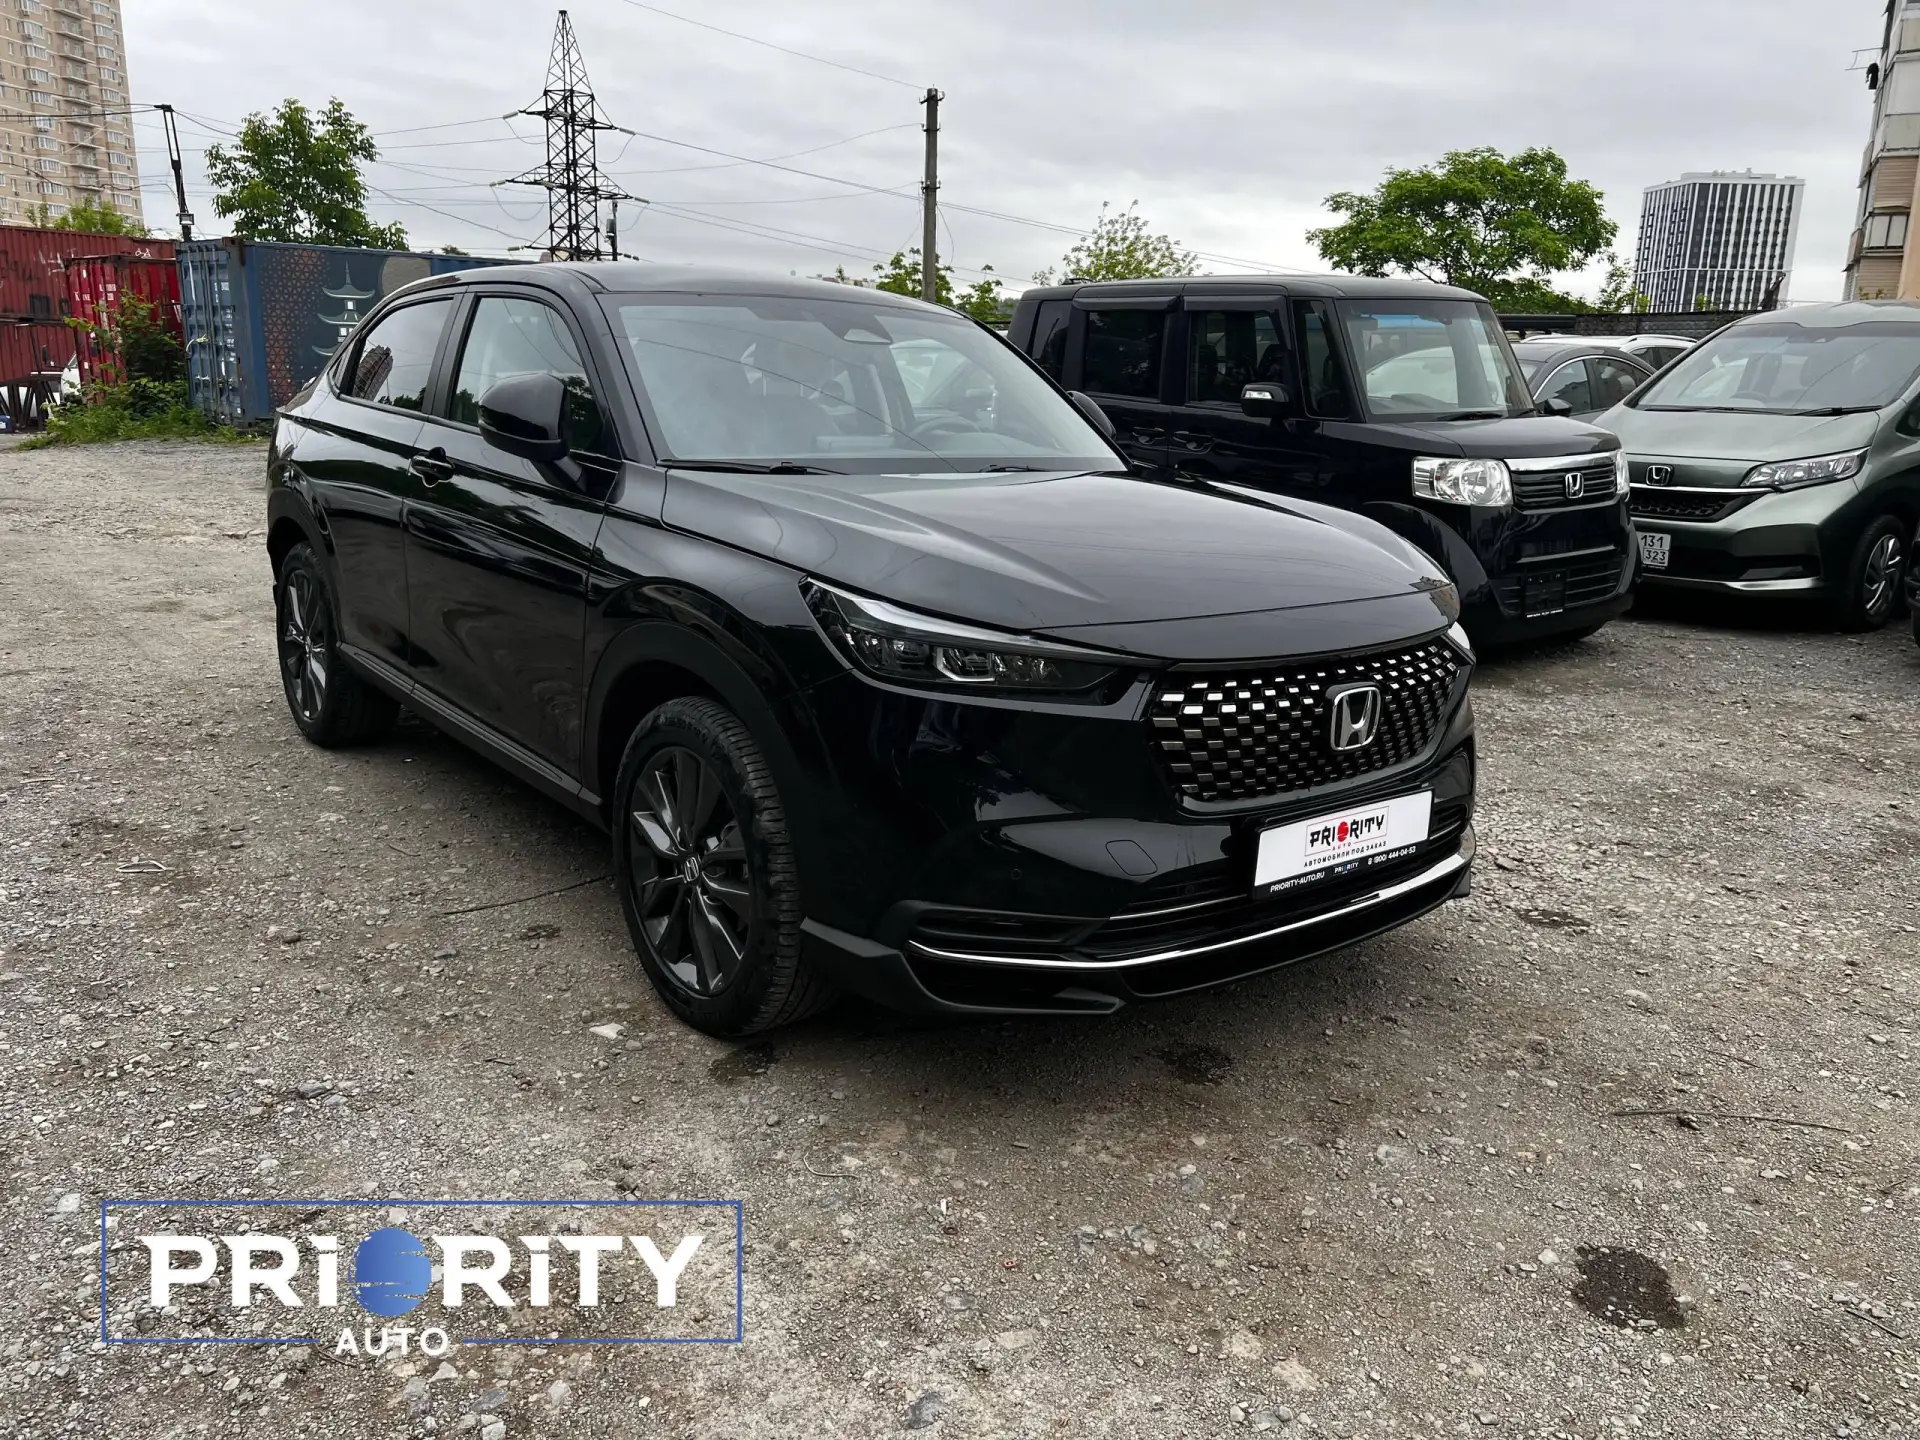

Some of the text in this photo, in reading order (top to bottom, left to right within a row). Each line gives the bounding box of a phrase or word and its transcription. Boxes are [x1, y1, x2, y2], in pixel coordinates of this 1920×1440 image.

[1641, 534, 1665, 549] 131
[1645, 549, 1666, 561] 323
[1309, 814, 1385, 848] PRIORITY
[1304, 840, 1387, 868] АВТОМОБИЛИ ПОД ЗАКАЗ
[1269, 871, 1325, 893] PRIORITY-AUTO.RU
